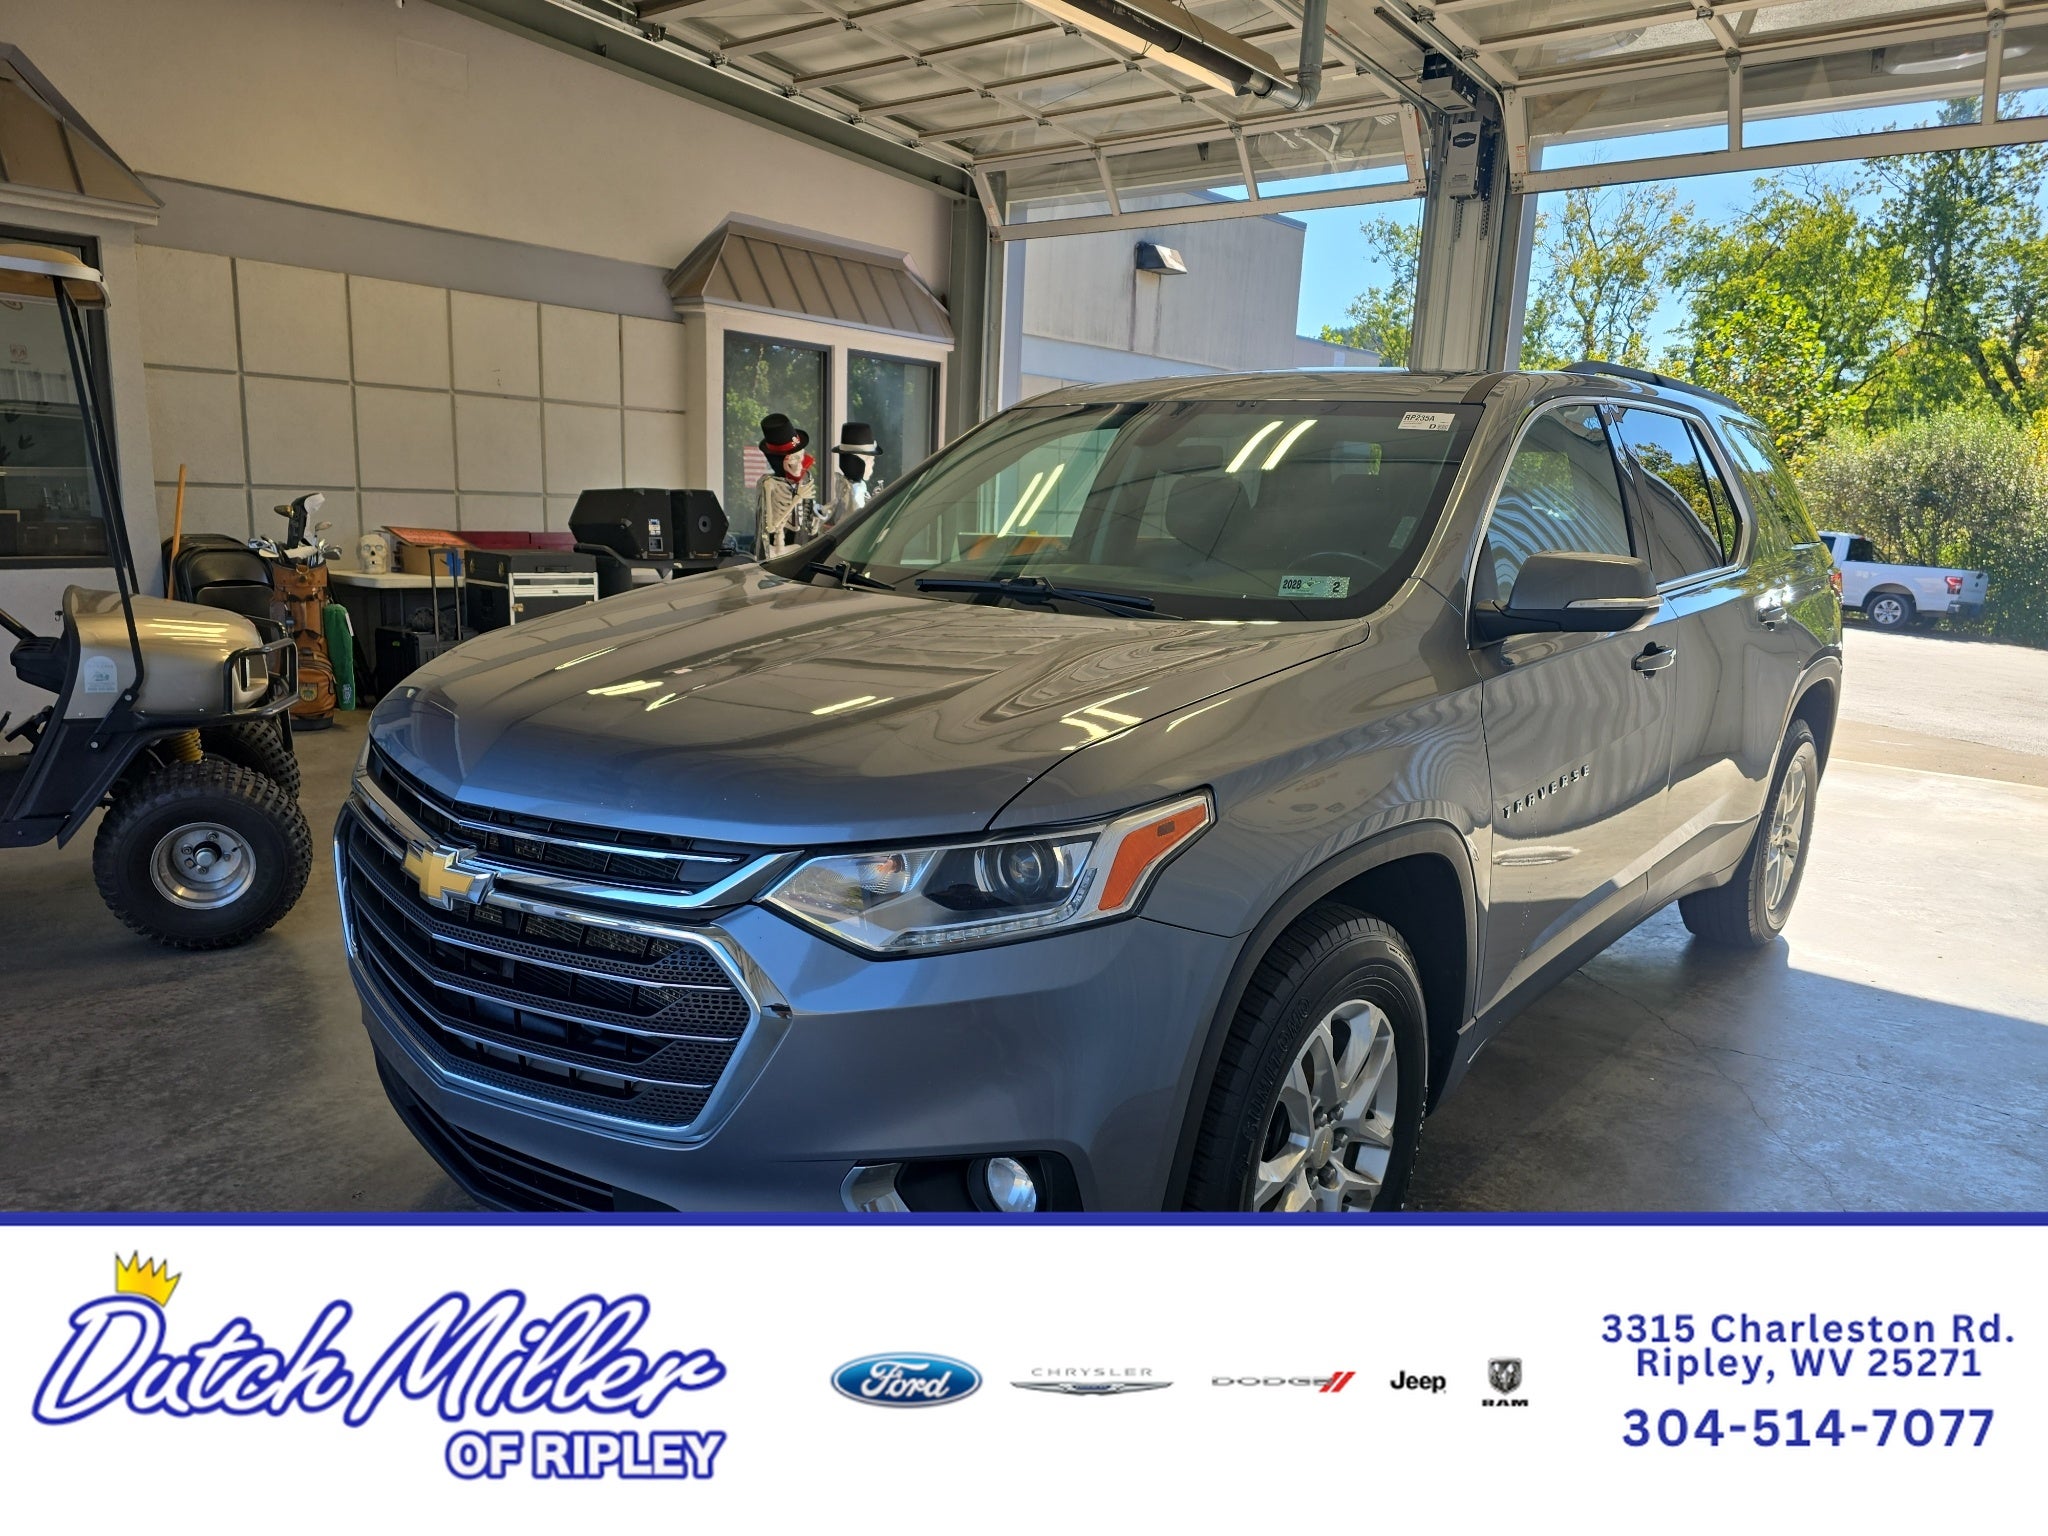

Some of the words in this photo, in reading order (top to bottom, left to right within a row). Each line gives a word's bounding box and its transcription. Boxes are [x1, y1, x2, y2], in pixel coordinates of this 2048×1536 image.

[1404, 414, 1435, 422] RP235A
[1332, 581, 1341, 593] 2
[1502, 764, 1590, 819] TRAVERSE
